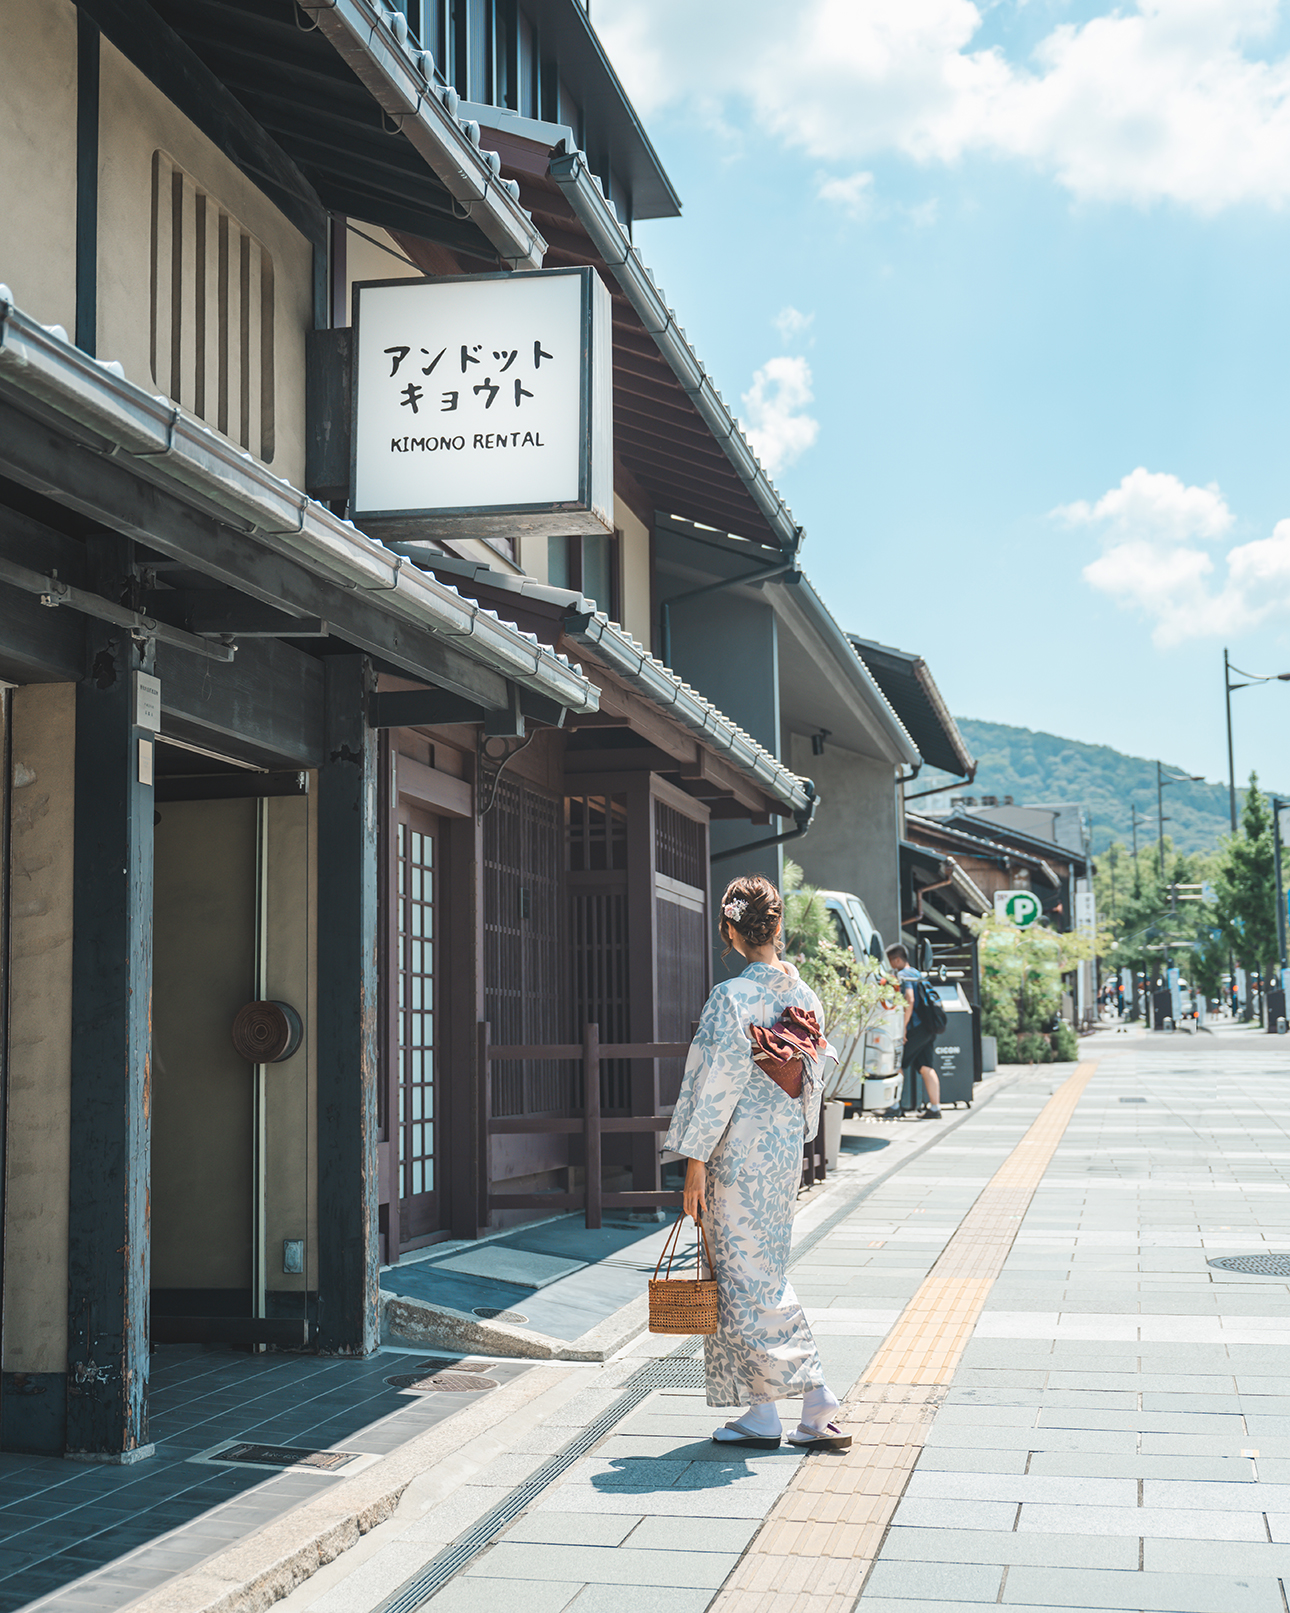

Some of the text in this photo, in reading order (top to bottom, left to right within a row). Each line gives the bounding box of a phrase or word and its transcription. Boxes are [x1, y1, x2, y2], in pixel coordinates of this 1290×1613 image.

[383, 340, 554, 378] アンドット
[400, 377, 535, 414] キョウト
[390, 431, 545, 453] KIMONO RENTAL
[1014, 898, 1035, 924] P
